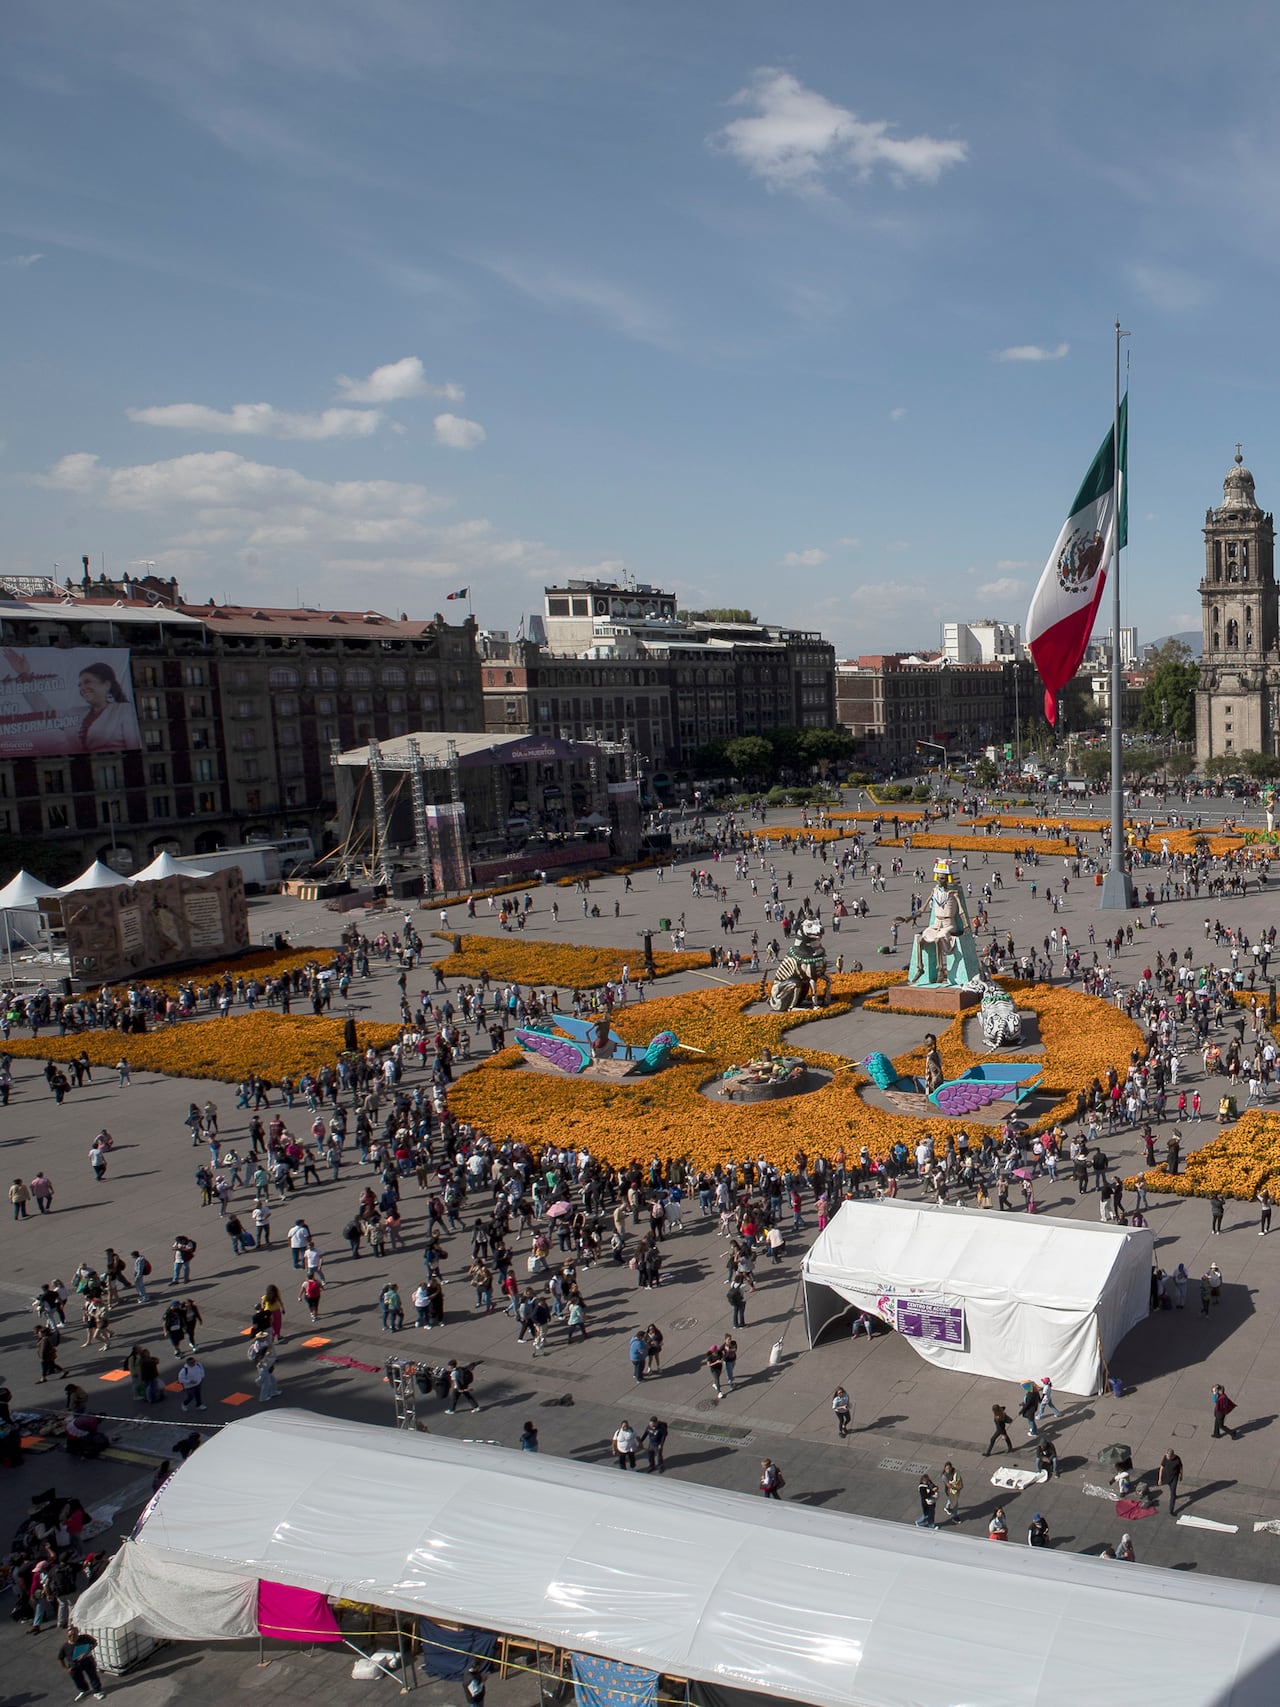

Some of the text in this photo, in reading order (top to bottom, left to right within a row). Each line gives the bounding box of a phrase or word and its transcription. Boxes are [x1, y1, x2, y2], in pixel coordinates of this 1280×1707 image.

[16, 679, 65, 693] BRUGADA
[528, 748, 555, 756] MUERTOS
[906, 1302, 926, 1310] CENTRO
